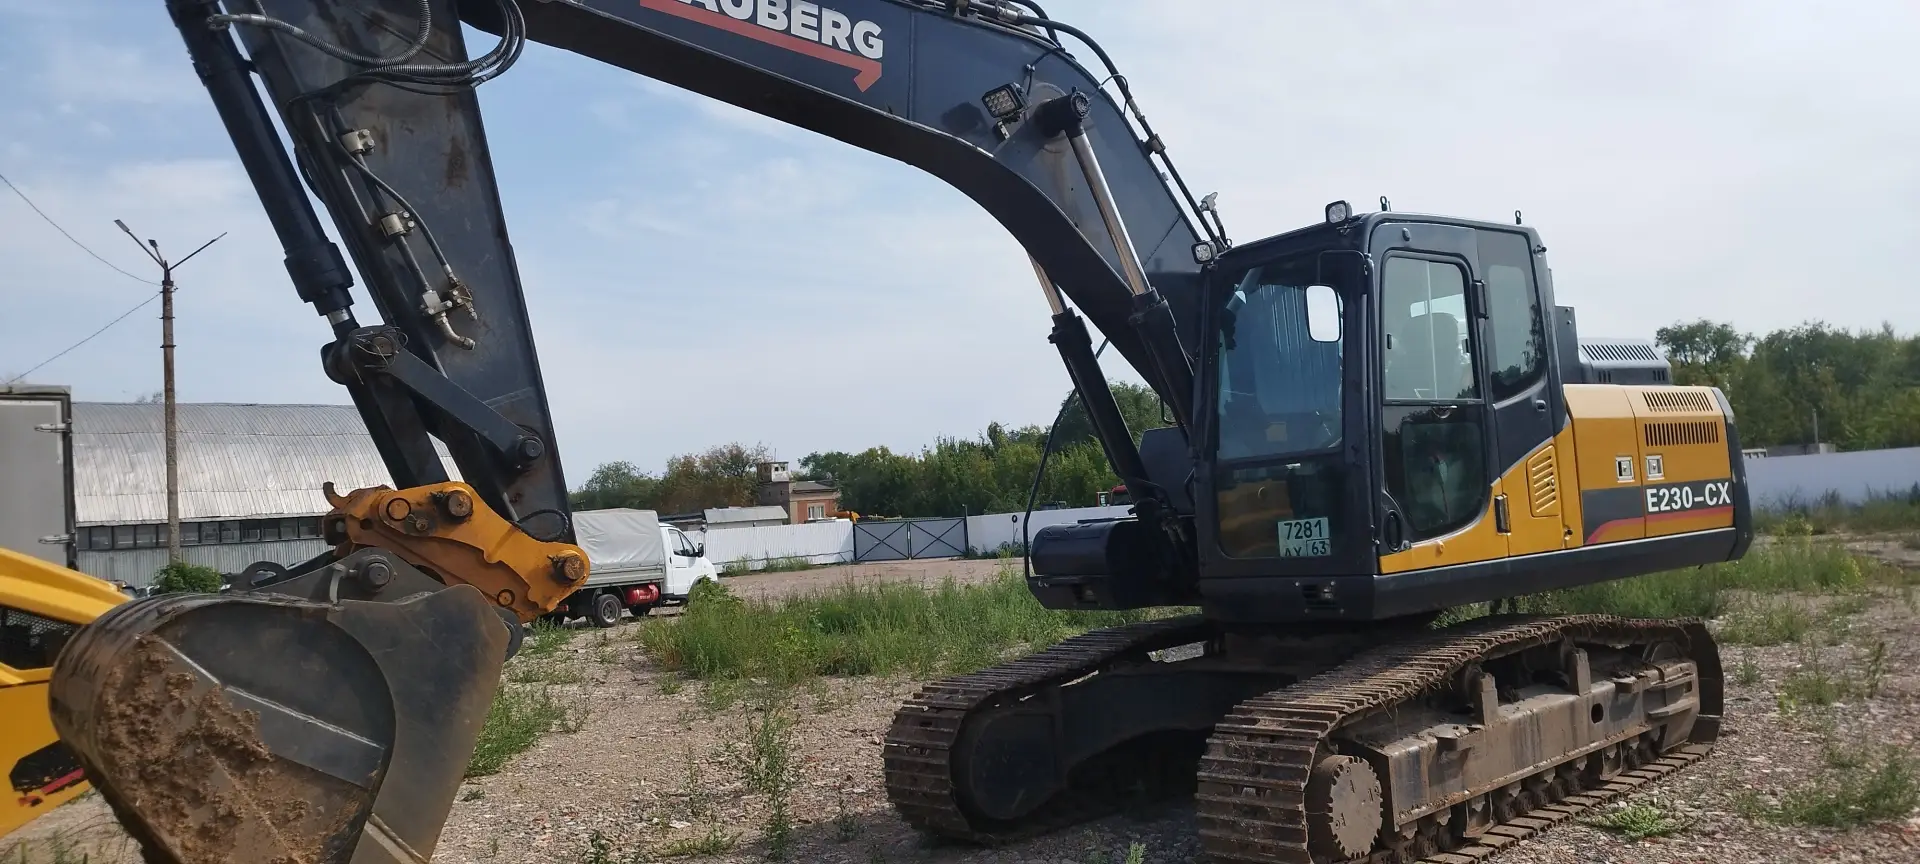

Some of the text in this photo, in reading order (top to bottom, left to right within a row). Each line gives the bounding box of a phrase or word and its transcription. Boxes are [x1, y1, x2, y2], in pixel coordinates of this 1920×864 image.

[1646, 482, 1731, 512] E230-CX
[1283, 519, 1322, 540] 7281
[1311, 541, 1327, 555] 63
